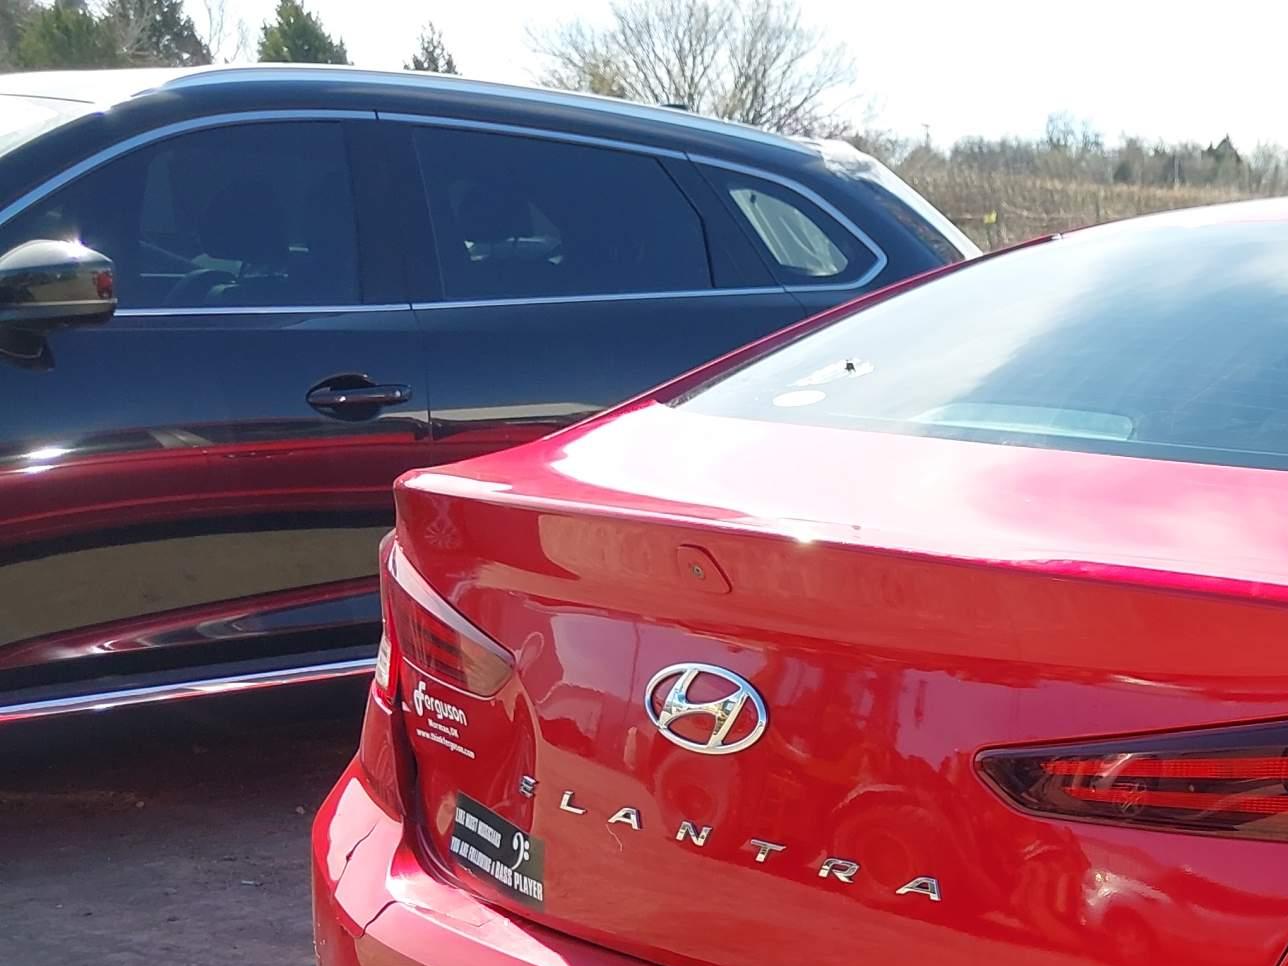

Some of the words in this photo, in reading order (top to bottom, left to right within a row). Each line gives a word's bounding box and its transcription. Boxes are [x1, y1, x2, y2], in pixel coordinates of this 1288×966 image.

[413, 681, 467, 726] Ferguson
[519, 775, 942, 902] ELANTRA
[494, 861, 513, 887] BASS
[513, 871, 543, 901] PLAYER
